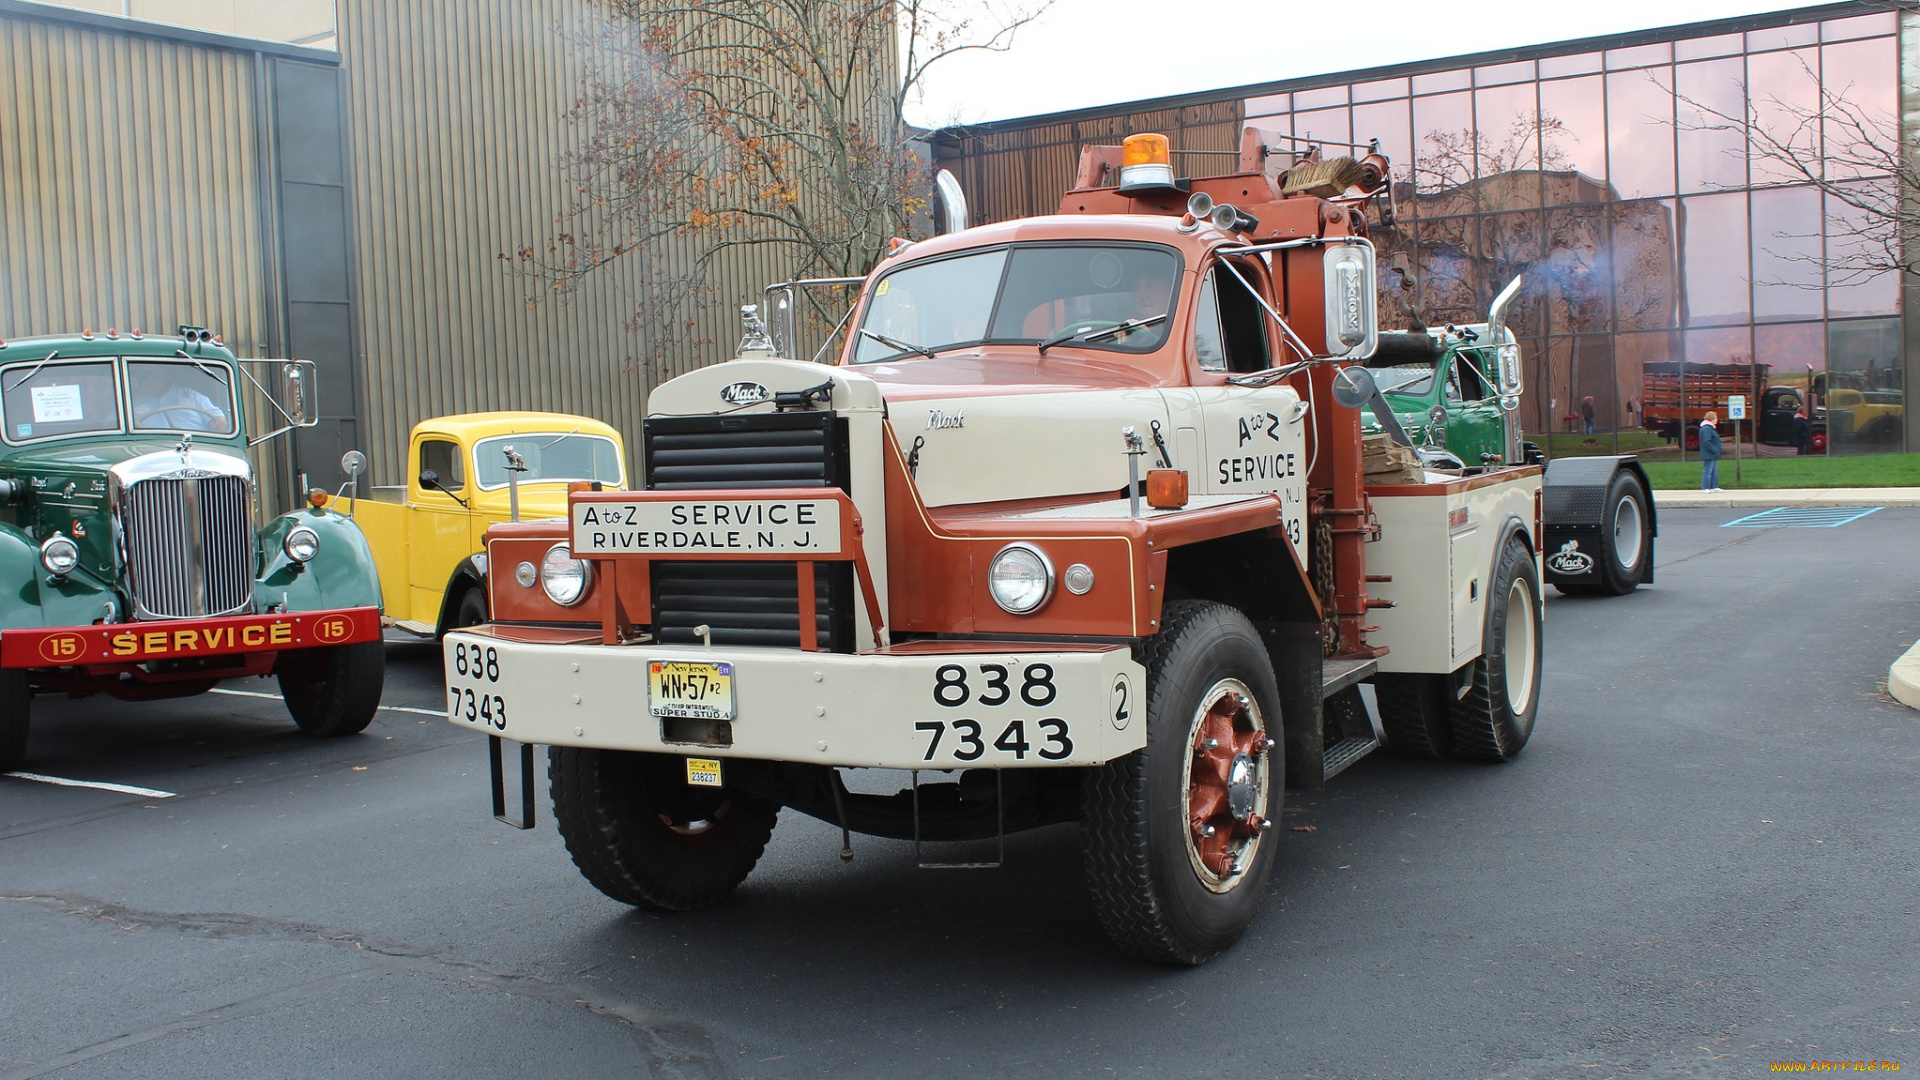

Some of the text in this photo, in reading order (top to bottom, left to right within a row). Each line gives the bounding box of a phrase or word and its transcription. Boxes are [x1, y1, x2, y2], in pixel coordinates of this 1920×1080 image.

[725, 384, 763, 401] Mack
[925, 408, 967, 430] Mack
[1219, 453, 1295, 485] SERVICE
[671, 503, 817, 525] SERVICE
[1554, 556, 1585, 568] Mack
[50, 620, 345, 656] 15 SERVICE 15
[456, 642, 500, 683] 838
[671, 663, 687, 673] New
[688, 663, 709, 674] Jersey
[933, 662, 1057, 707] 838
[451, 686, 507, 731] 7343
[653, 707, 687, 717] SUPER
[693, 710, 720, 719] STUD
[1114, 680, 1129, 722] 2
[914, 717, 1074, 761] 7343
